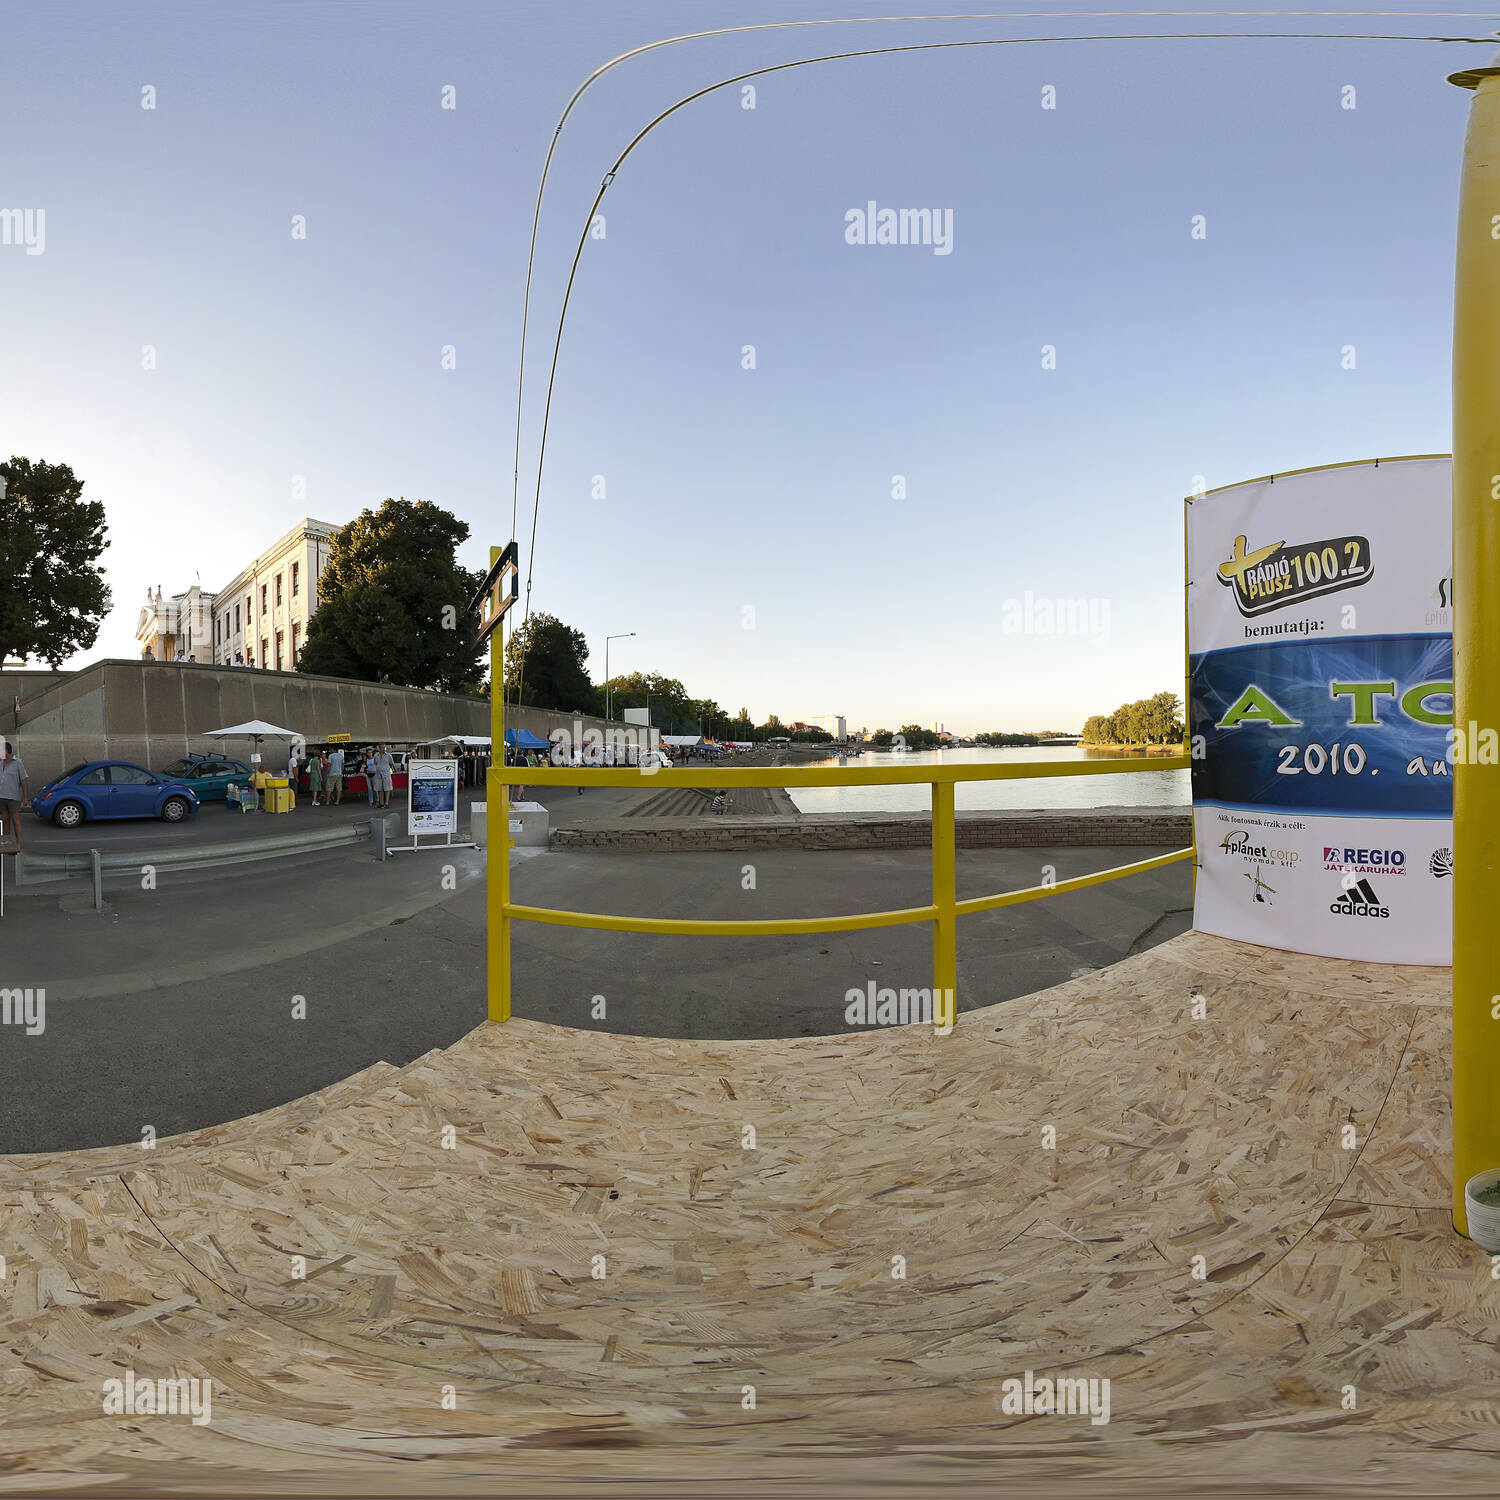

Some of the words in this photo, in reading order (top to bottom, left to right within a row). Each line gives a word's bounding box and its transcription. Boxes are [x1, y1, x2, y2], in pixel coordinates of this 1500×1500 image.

[1247, 555, 1290, 585] RÁDIÓ
[1291, 541, 1365, 587] 100.2
[1250, 574, 1293, 600] PLUSZ
[1244, 618, 1325, 637] bemutatja:
[1215, 683, 1302, 729] A
[1276, 743, 1379, 776] 2010.
[1231, 816, 1262, 826] fontosnak
[1263, 819, 1281, 829] érzik
[1288, 822, 1306, 830] célt:
[1243, 856, 1275, 866] nyomda
[1269, 849, 1302, 863] corp.
[1344, 848, 1405, 866] REGIO
[1323, 863, 1405, 875] JÁTÉKÁRUHÁZ
[1329, 902, 1390, 918] adidas
